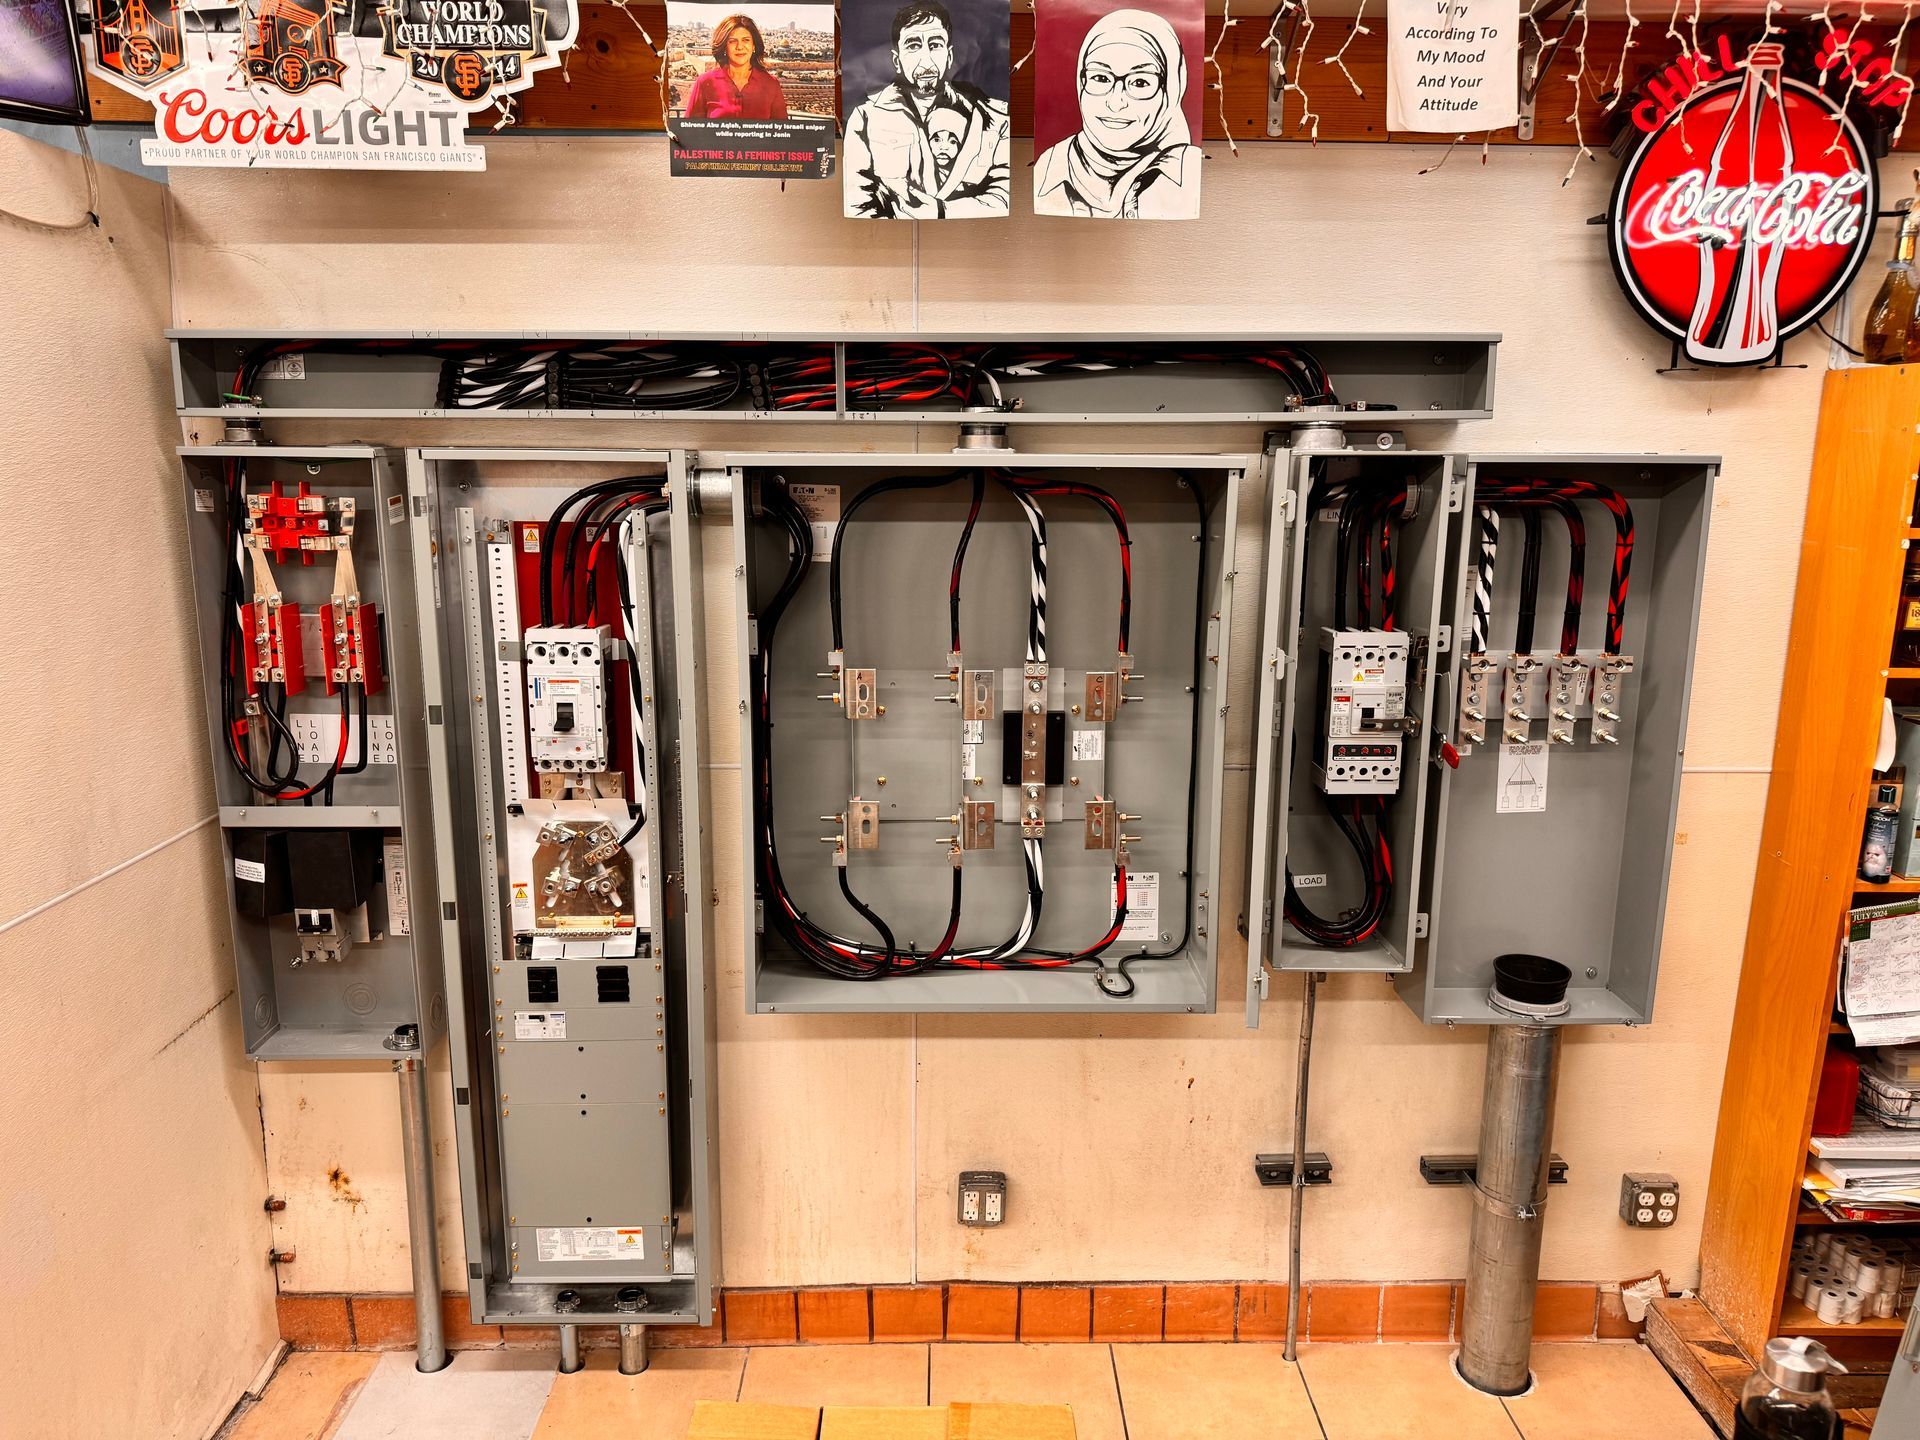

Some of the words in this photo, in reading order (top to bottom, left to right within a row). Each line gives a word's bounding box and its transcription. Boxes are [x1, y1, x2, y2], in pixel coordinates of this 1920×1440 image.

[420, 1, 504, 22] WORLD
[398, 24, 530, 45] CHAMPIONS
[1405, 26, 1475, 43] According
[1480, 27, 1498, 39] To
[1416, 50, 1440, 65] My
[1443, 50, 1486, 63] Mood
[1417, 75, 1446, 87] And
[1450, 76, 1484, 88] Your
[1632, 35, 1738, 132] CHILL
[1419, 98, 1479, 111] Attitude
[159, 88, 311, 145] Coors
[313, 109, 457, 146] LIGHT
[149, 148, 181, 158] PROUD
[185, 149, 226, 158] PARTNER
[231, 149, 241, 159] OF
[246, 150, 271, 159] YUR
[274, 151, 307, 160] WORLD
[310, 150, 359, 161] CHAMPION
[362, 151, 380, 161] SAN
[384, 151, 436, 162] FRANCISCO
[674, 149, 724, 160] PALESTINE
[725, 151, 734, 160] IS
[736, 151, 743, 160] A
[745, 151, 785, 161] FEMINIST
[788, 152, 814, 162] ISSUE
[310, 720, 320, 763] LOAD
[371, 720, 380, 763] LINE
[385, 720, 395, 763] LOAD
[1299, 876, 1323, 885] LOAD
[1852, 912, 1871, 923] JULY
[1871, 910, 1888, 918] 2024
